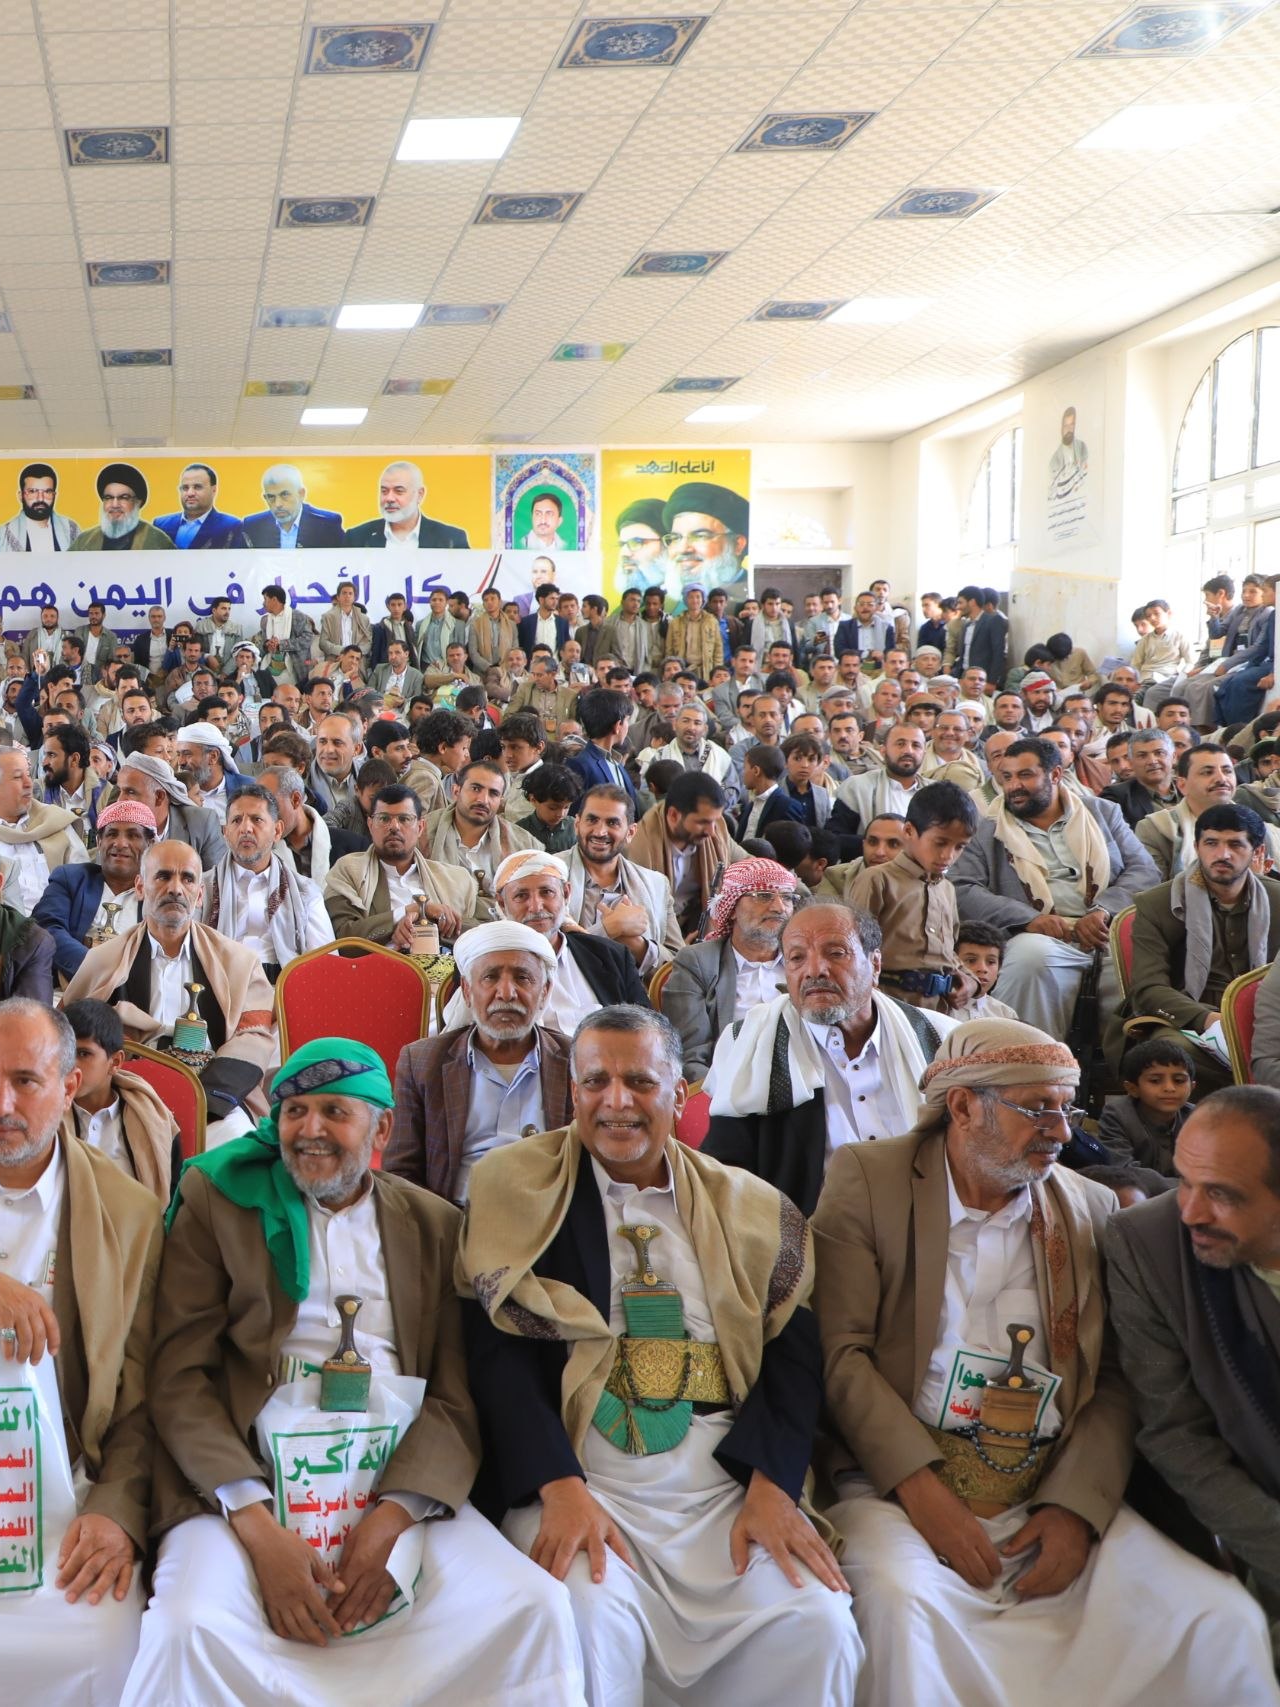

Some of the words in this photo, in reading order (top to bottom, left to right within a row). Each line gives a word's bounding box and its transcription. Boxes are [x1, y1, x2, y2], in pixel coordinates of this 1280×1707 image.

[71, 576, 172, 618] اليمن
[188, 571, 245, 622] في
[405, 573, 452, 611] كل
[284, 1434, 354, 1487] أكبر
[287, 1486, 348, 1518] لأمريكا
